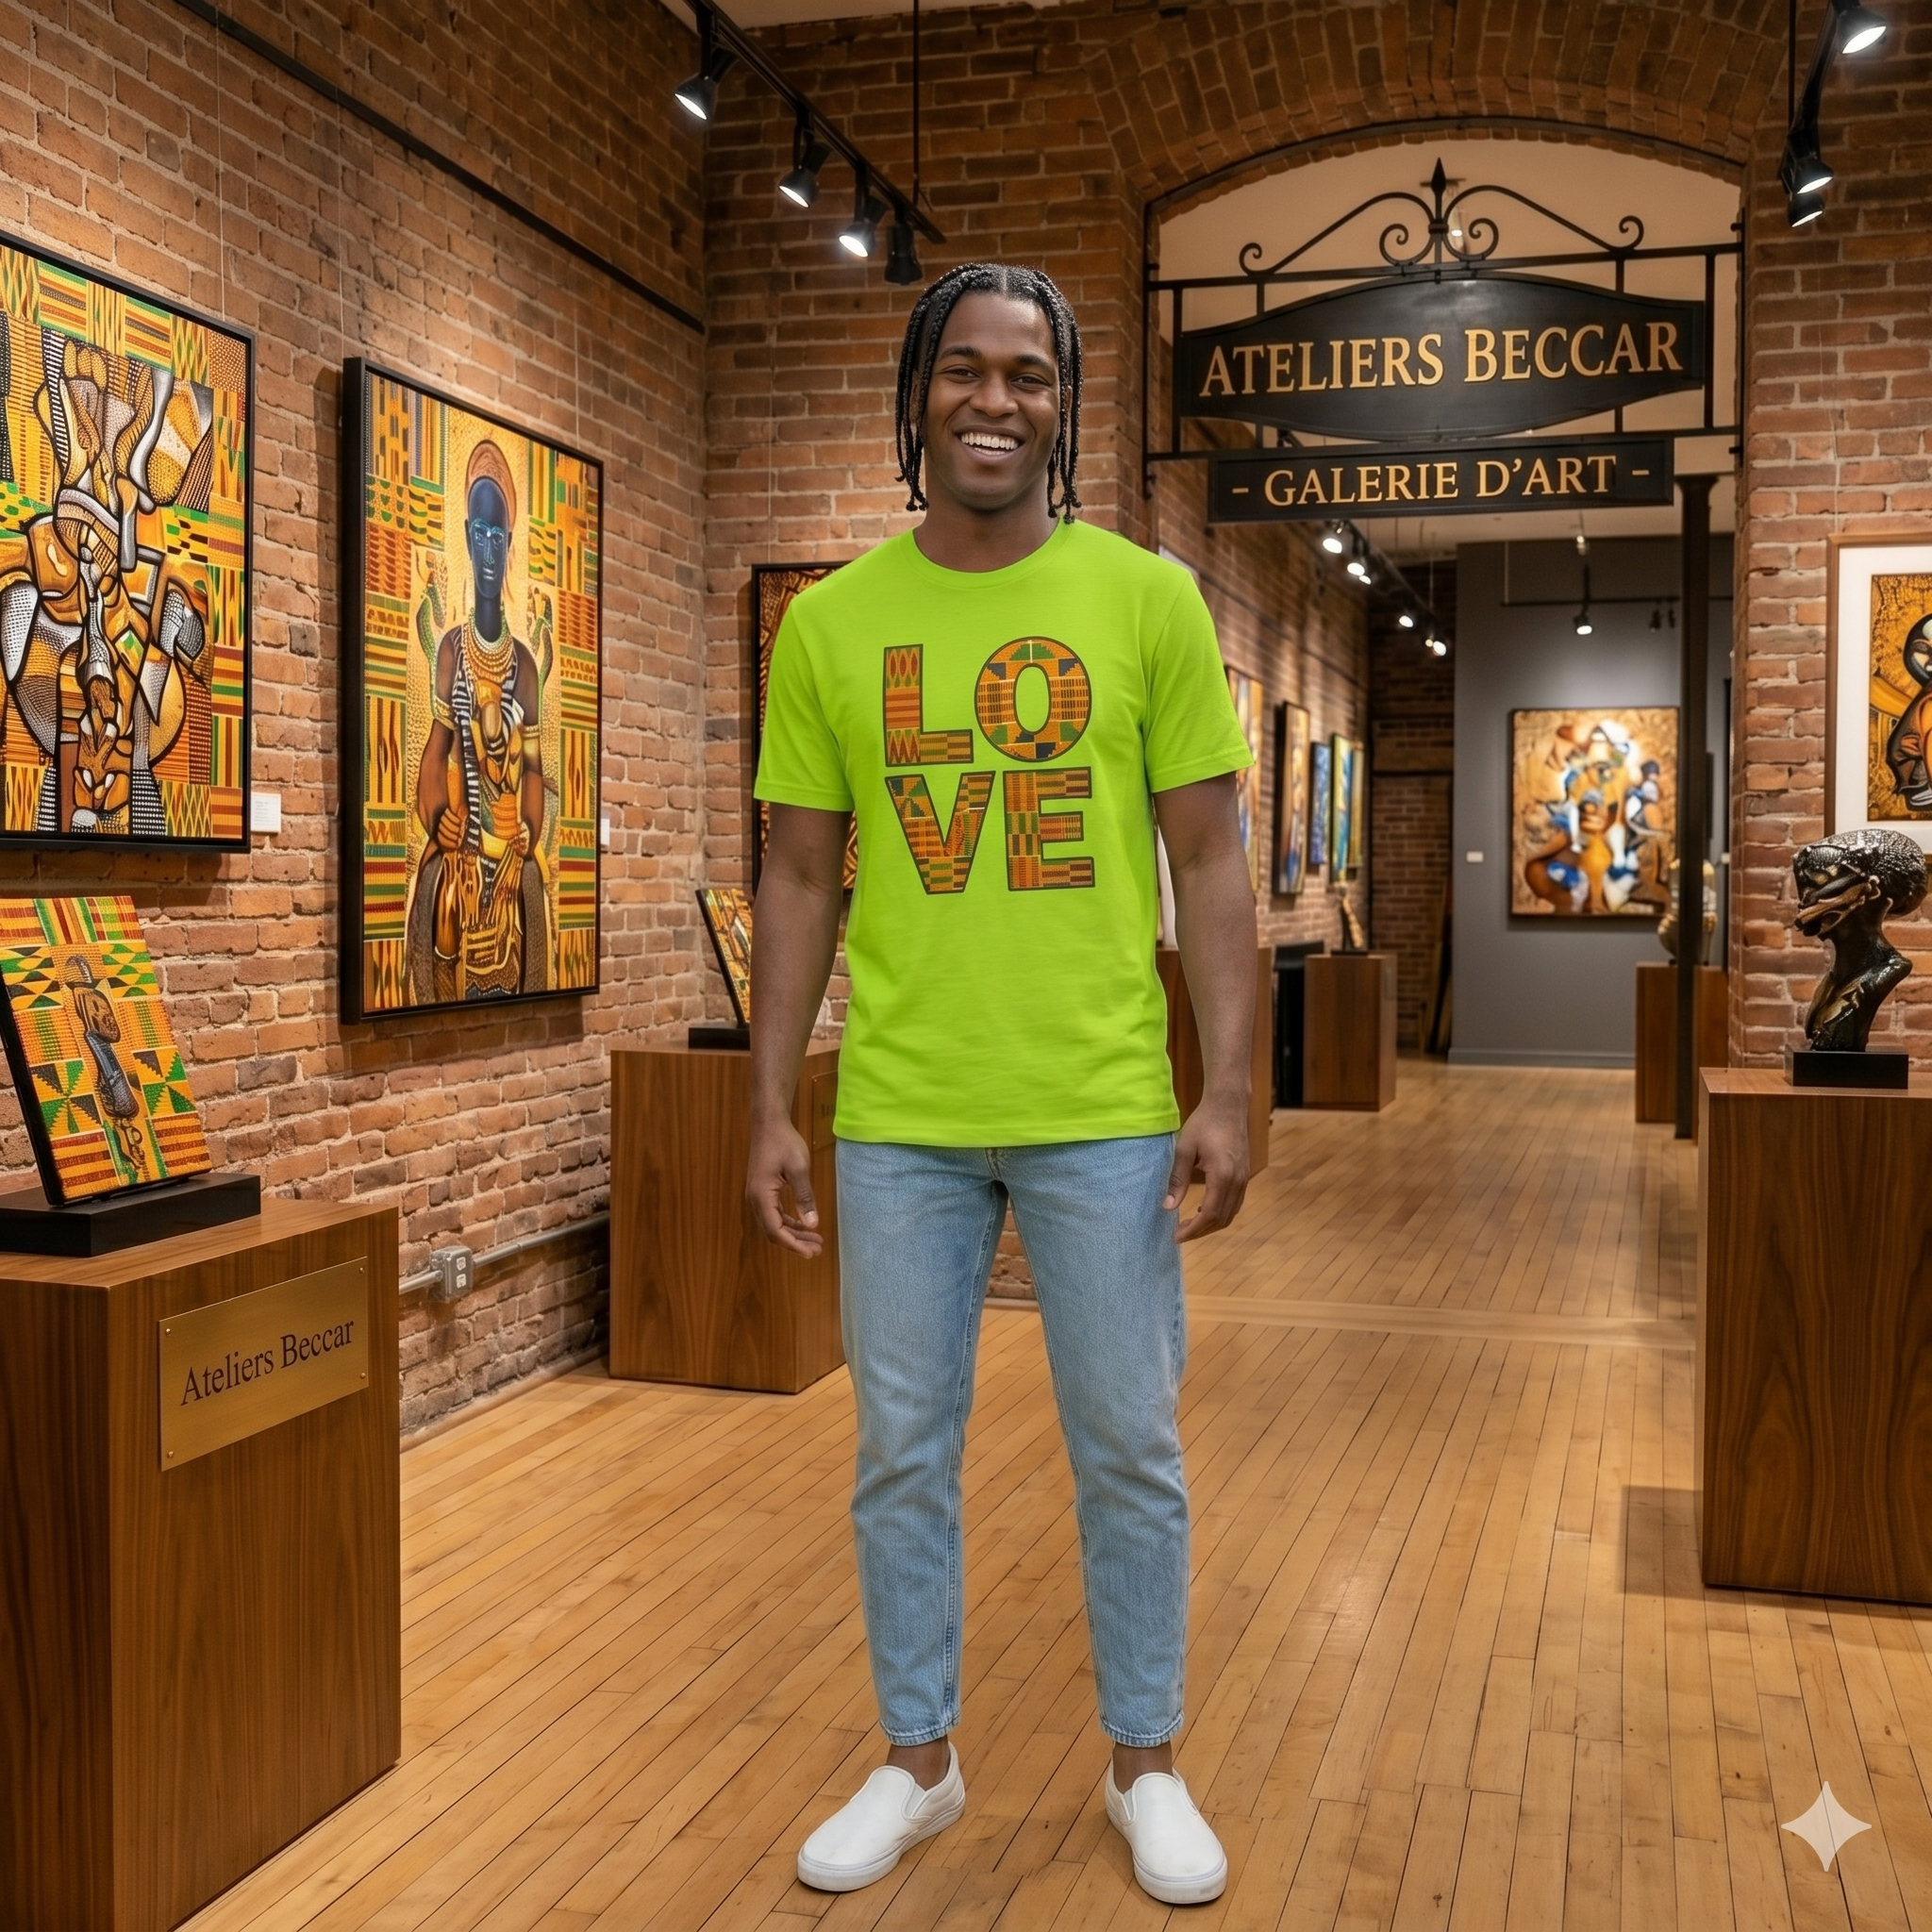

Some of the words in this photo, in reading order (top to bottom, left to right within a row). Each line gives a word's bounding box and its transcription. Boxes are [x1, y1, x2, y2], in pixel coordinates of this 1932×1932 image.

[1199, 333, 1443, 397] ATELIERS
[1464, 322, 1683, 383] BECCAR
[1264, 461, 1459, 507] GALERIE
[1476, 455, 1616, 498] D’ART
[883, 636, 1092, 767] LO
[884, 766, 1095, 895] VE
[180, 1350, 274, 1407] Ateliers
[279, 1321, 355, 1370] Beccar
